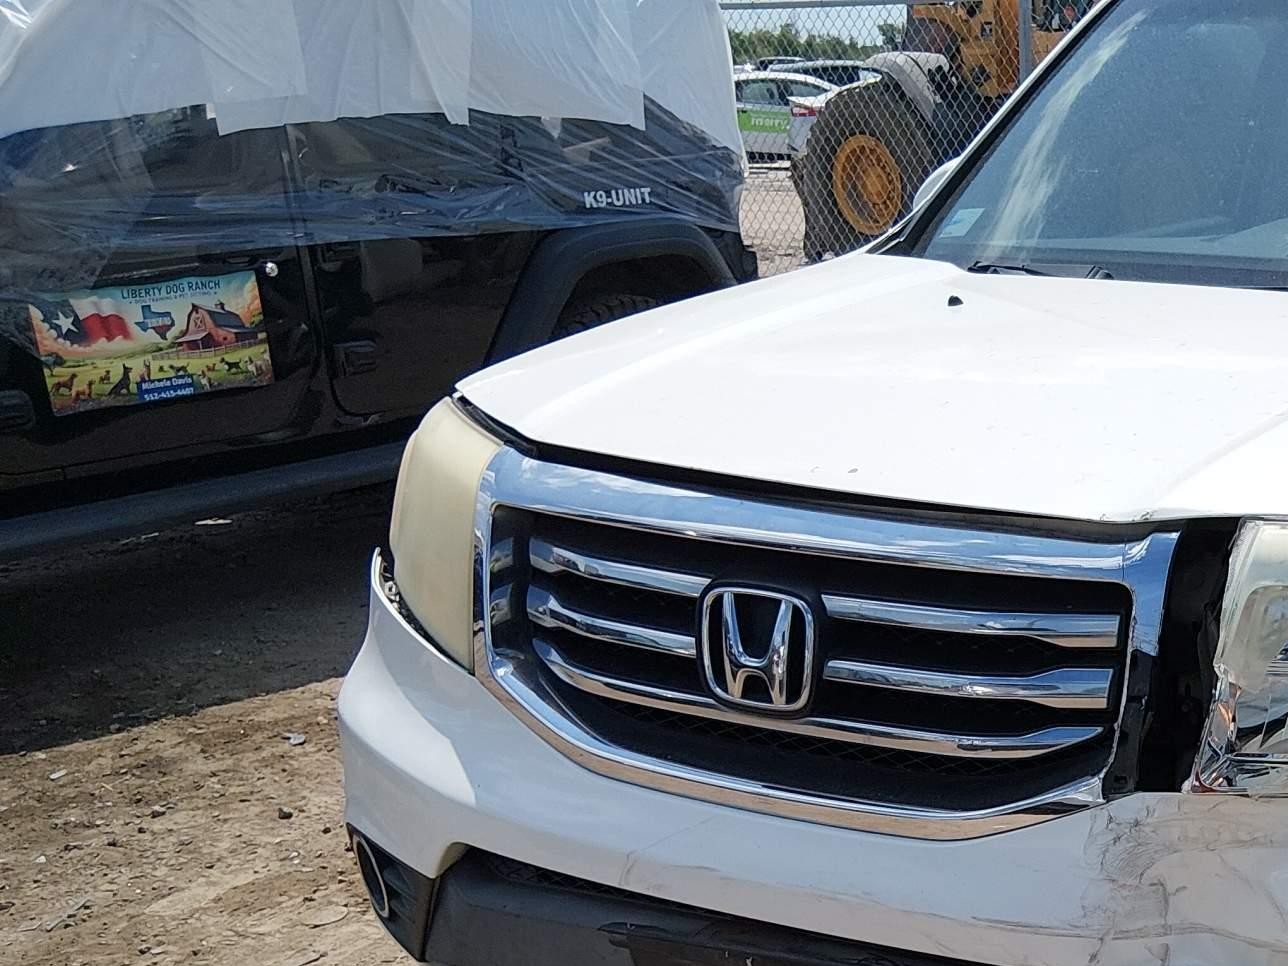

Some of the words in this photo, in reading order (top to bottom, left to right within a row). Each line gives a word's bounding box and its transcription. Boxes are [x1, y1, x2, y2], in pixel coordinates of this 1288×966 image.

[583, 187, 651, 209] K9-UNIT
[121, 286, 163, 300] LIBERTY
[166, 283, 185, 295] DOG
[188, 279, 221, 292] RANCH
[172, 376, 192, 386] Davis
